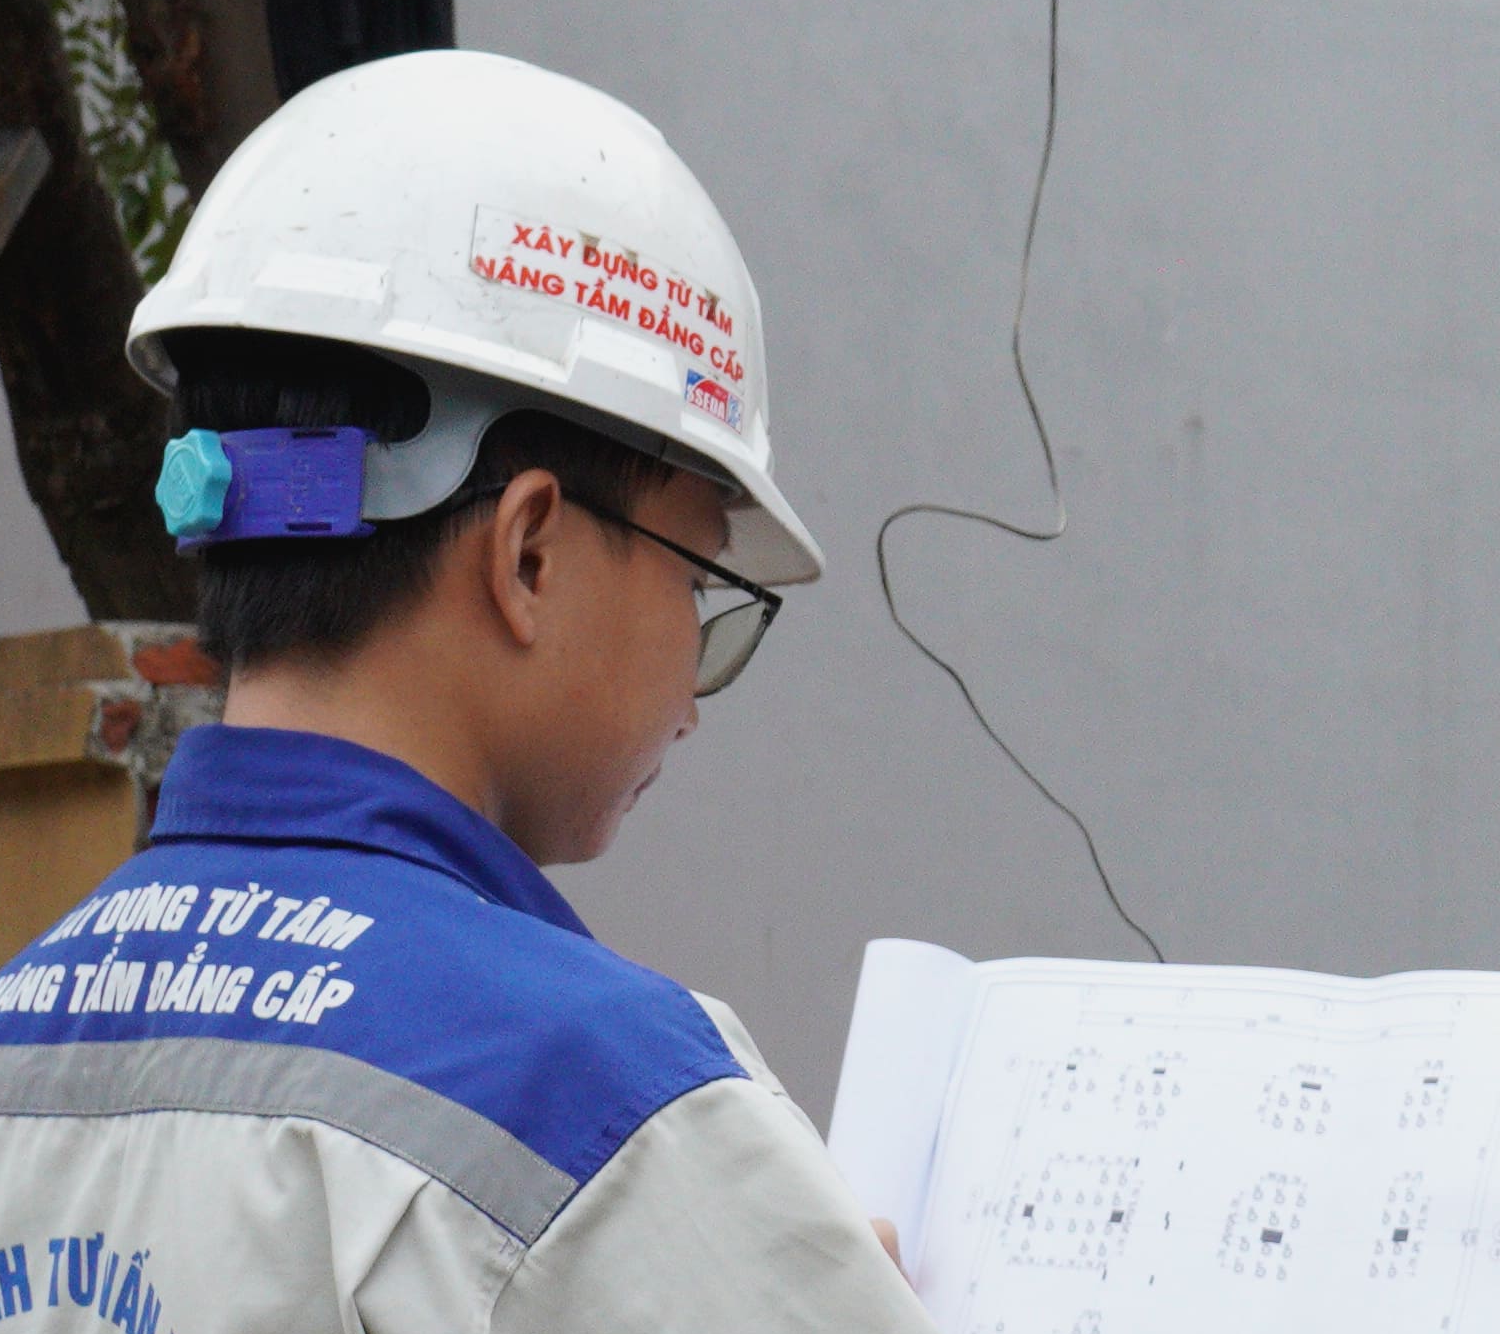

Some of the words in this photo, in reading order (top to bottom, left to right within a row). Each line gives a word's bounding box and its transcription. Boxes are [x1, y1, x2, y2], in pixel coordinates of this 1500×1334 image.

[512, 222, 574, 259] XÂY
[475, 255, 565, 296] NÂNG
[92, 881, 200, 944] DỰNG
[197, 882, 273, 936] TỪ
[257, 896, 375, 951] TÂM
[252, 961, 355, 1025] CẤP
[48, 1232, 104, 1308] TƯ
